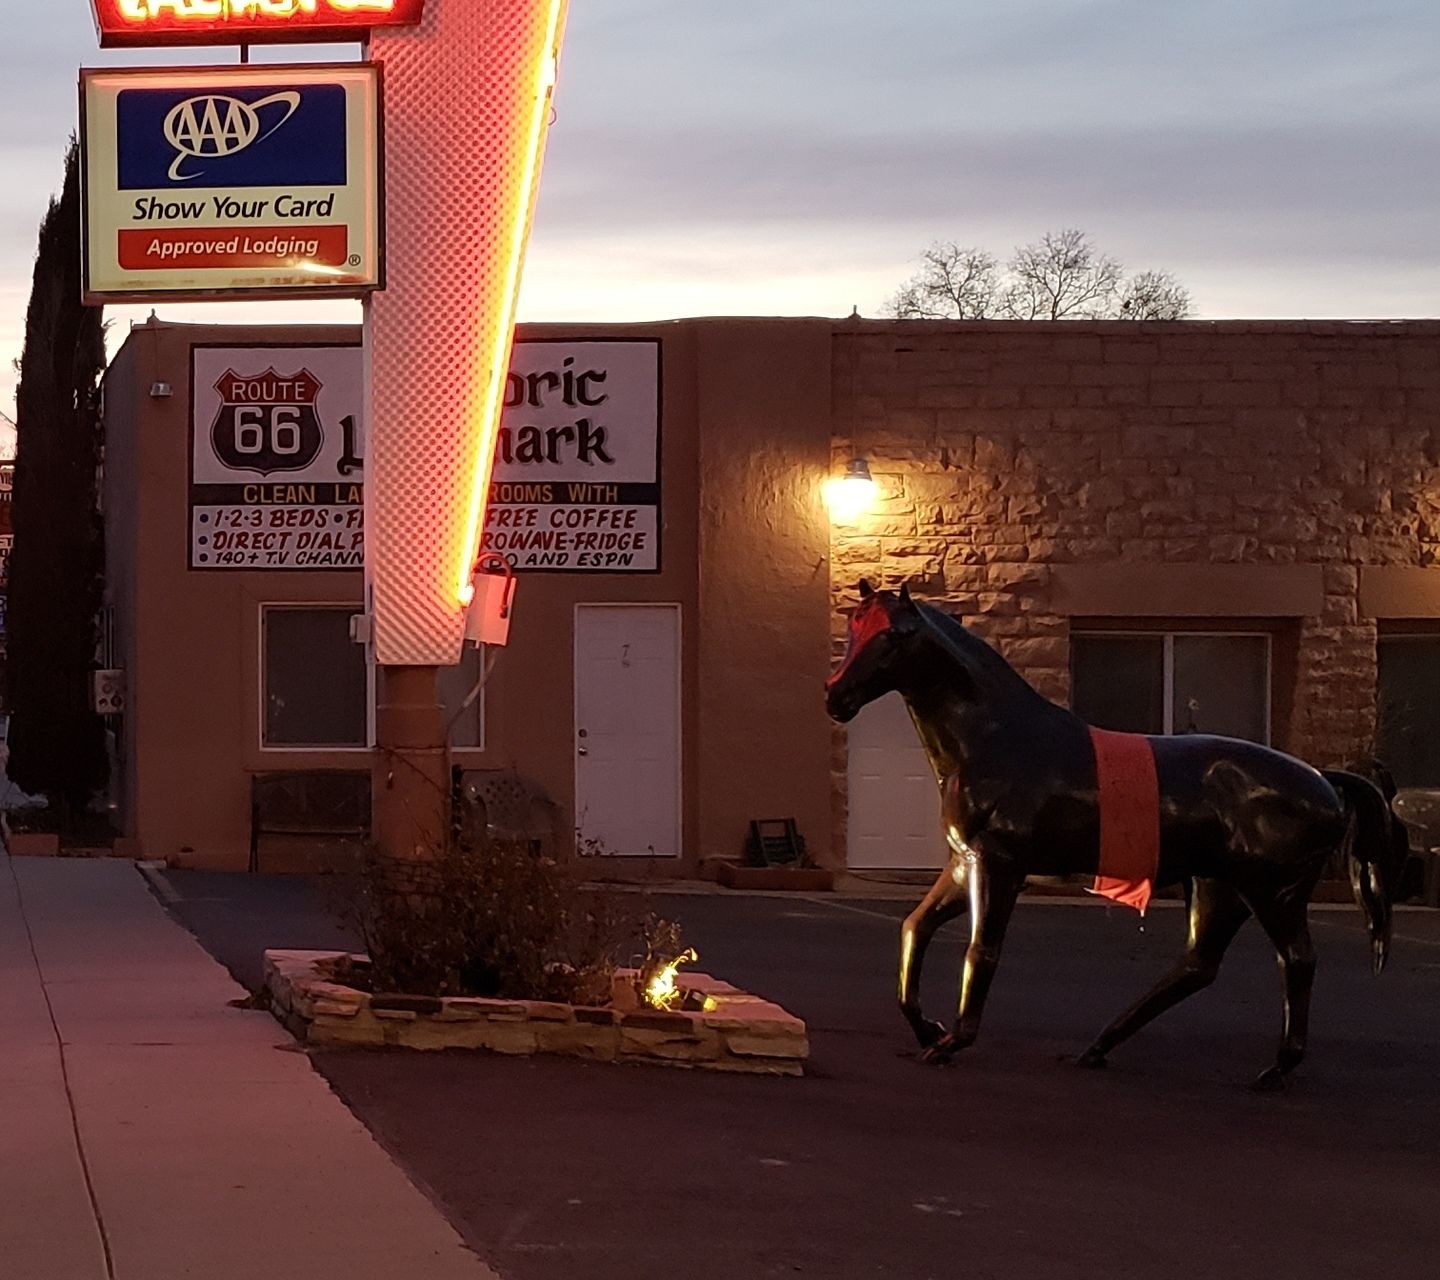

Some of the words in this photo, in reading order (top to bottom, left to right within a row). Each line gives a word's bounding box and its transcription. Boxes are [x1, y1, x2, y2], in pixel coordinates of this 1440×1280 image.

[172, 96, 250, 155] AAA
[133, 196, 206, 220] Show
[213, 196, 268, 219] Your
[274, 193, 335, 218] Card
[146, 236, 239, 259] Approved
[243, 237, 319, 257] Lodging
[231, 382, 306, 402] ROUTE
[234, 406, 302, 455] 66
[243, 484, 315, 504] CLEAN
[489, 484, 553, 503] ROOMS
[568, 483, 618, 503] WITH
[269, 509, 329, 528] BEDS
[485, 508, 539, 528] FREE
[550, 508, 638, 529] COFFEE
[212, 531, 292, 550] DIRECT
[296, 532, 346, 550] DIAL
[295, 551, 364, 565] CHANN
[525, 552, 569, 566] AND
[577, 552, 634, 566] ESPN
